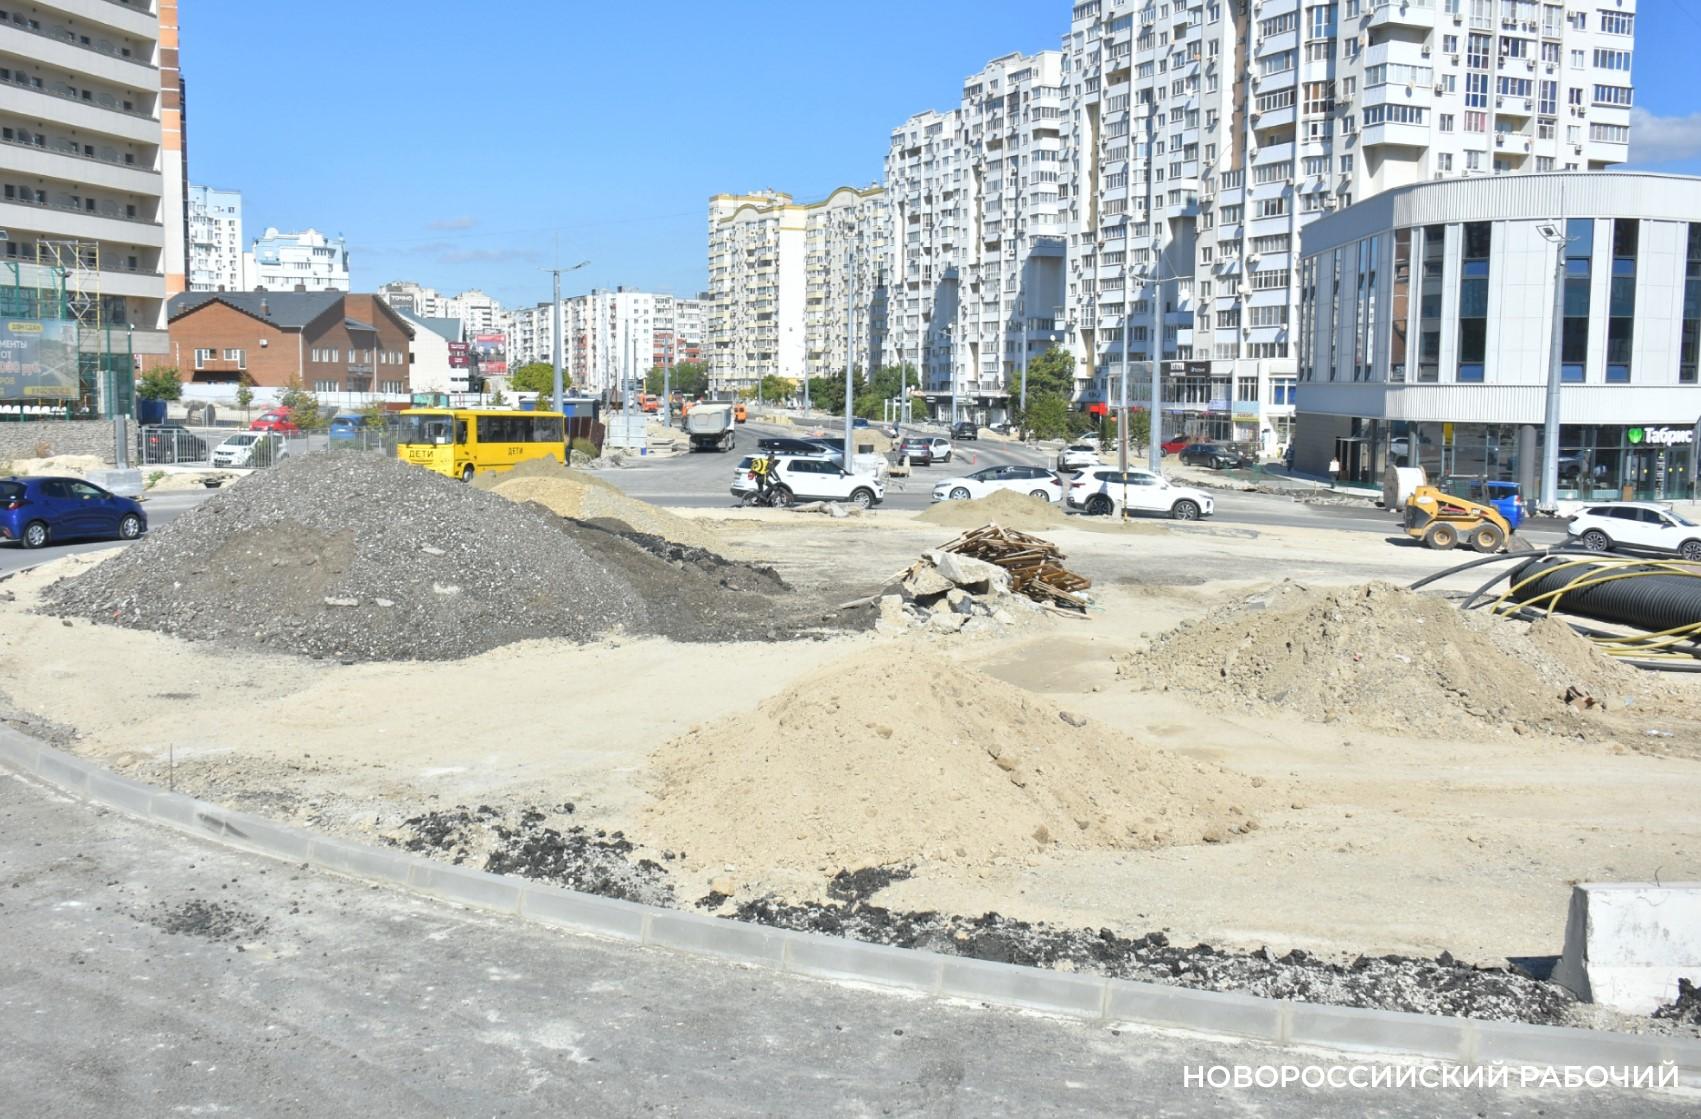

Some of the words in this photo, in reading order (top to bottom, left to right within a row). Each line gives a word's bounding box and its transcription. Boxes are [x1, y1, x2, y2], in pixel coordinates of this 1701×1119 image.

[1644, 427, 1693, 447] Табрис
[409, 450, 434, 458] ДЕТИ
[508, 447, 523, 456] ДЕТИ
